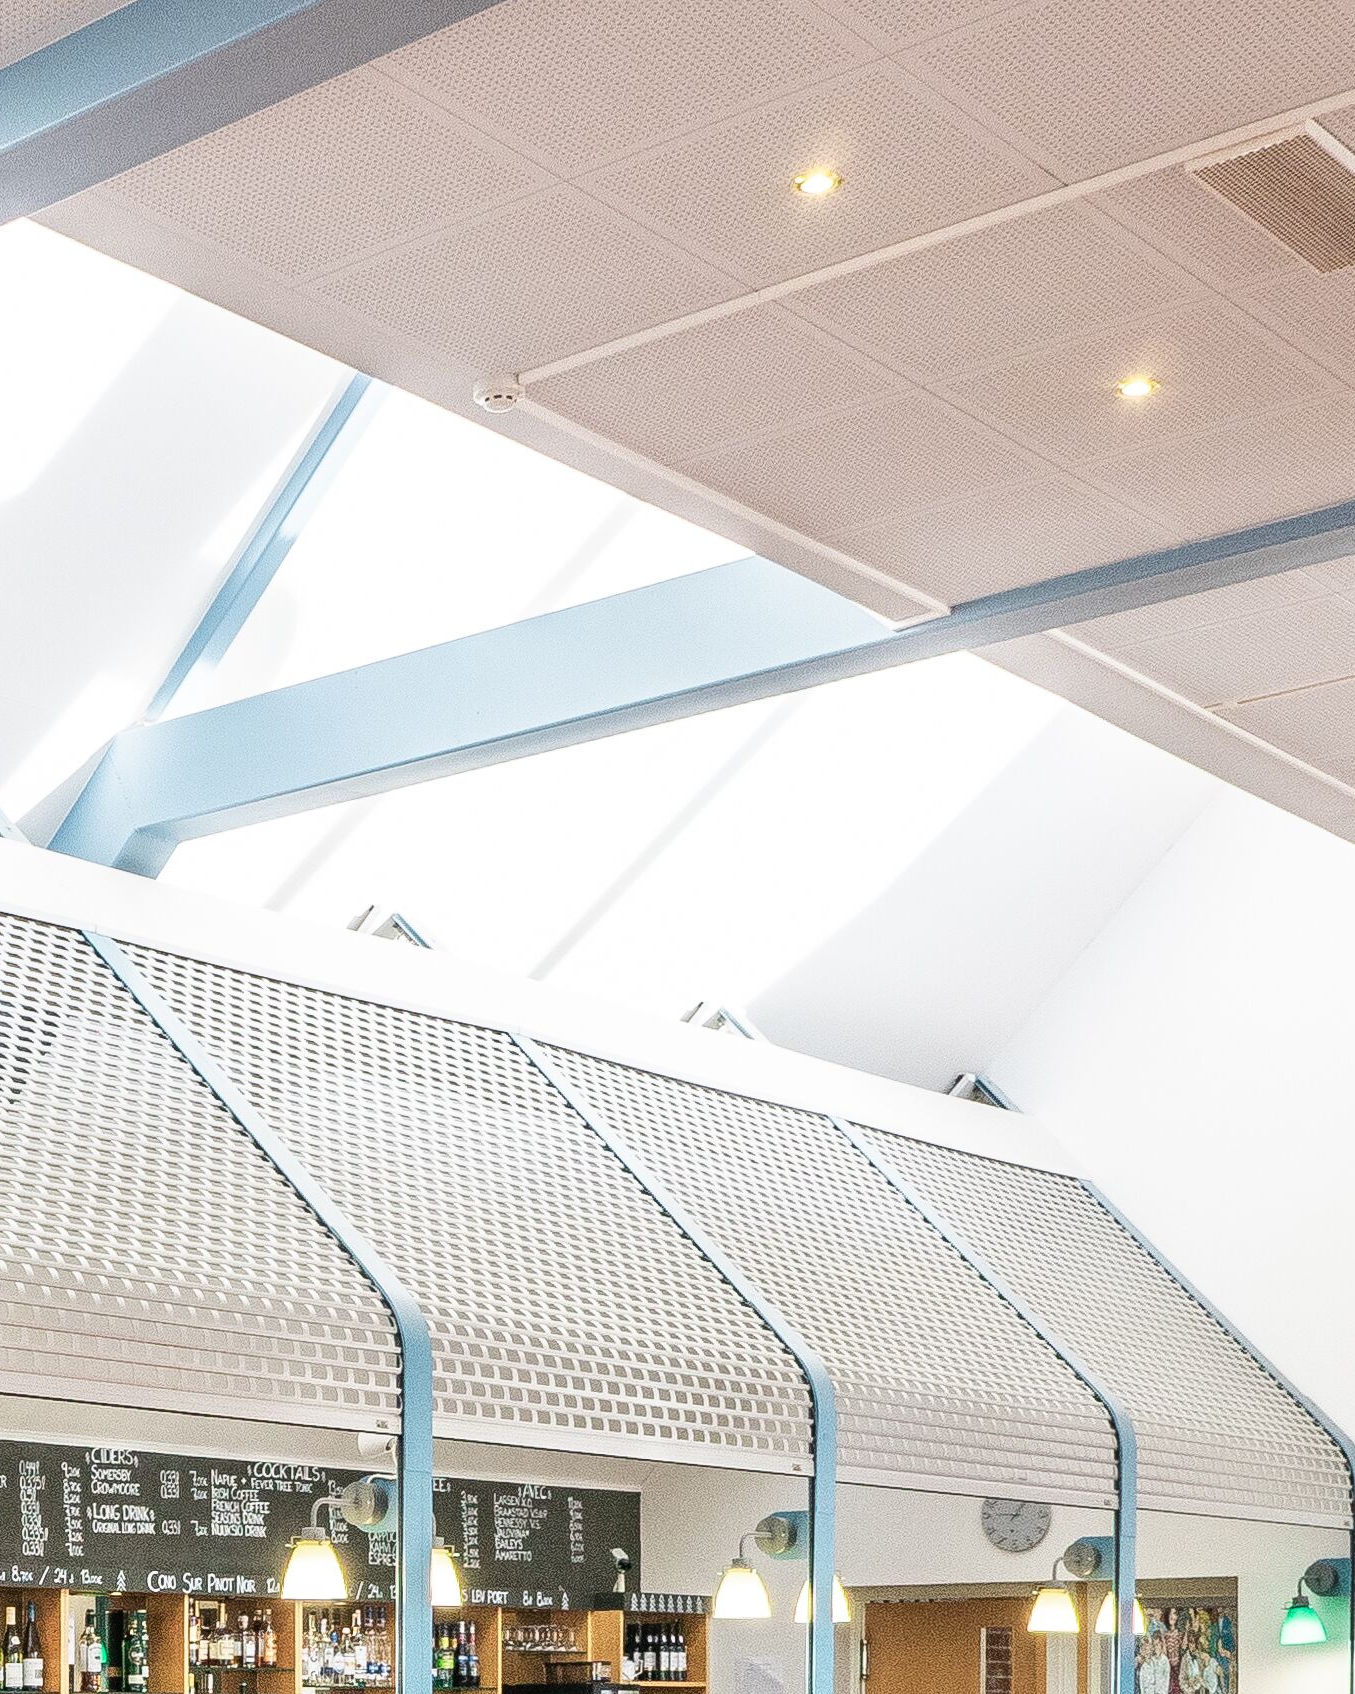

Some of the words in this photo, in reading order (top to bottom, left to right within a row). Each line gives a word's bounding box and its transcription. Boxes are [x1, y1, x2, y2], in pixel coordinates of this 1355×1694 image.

[91, 1448, 133, 1465] CIDERS
[91, 1464, 132, 1481] SOMERSBY
[253, 1462, 320, 1482] COCKTAILS
[251, 1477, 274, 1491] FEVER
[276, 1480, 293, 1492] TREE
[211, 1485, 229, 1500] IRISH
[231, 1486, 260, 1502] COFFEE
[93, 1502, 120, 1520] LONG
[122, 1505, 150, 1521] DRINK
[211, 1499, 240, 1513] FRENCH
[241, 1499, 270, 1515] COFFEE
[243, 1512, 265, 1527] DRINK
[245, 1525, 267, 1539] DRINK
[368, 1551, 396, 1567] ESPRES
[147, 1570, 176, 1592] CONO
[182, 1572, 203, 1594] SUR
[207, 1573, 234, 1594] PINOT
[487, 1589, 509, 1604] PORT
